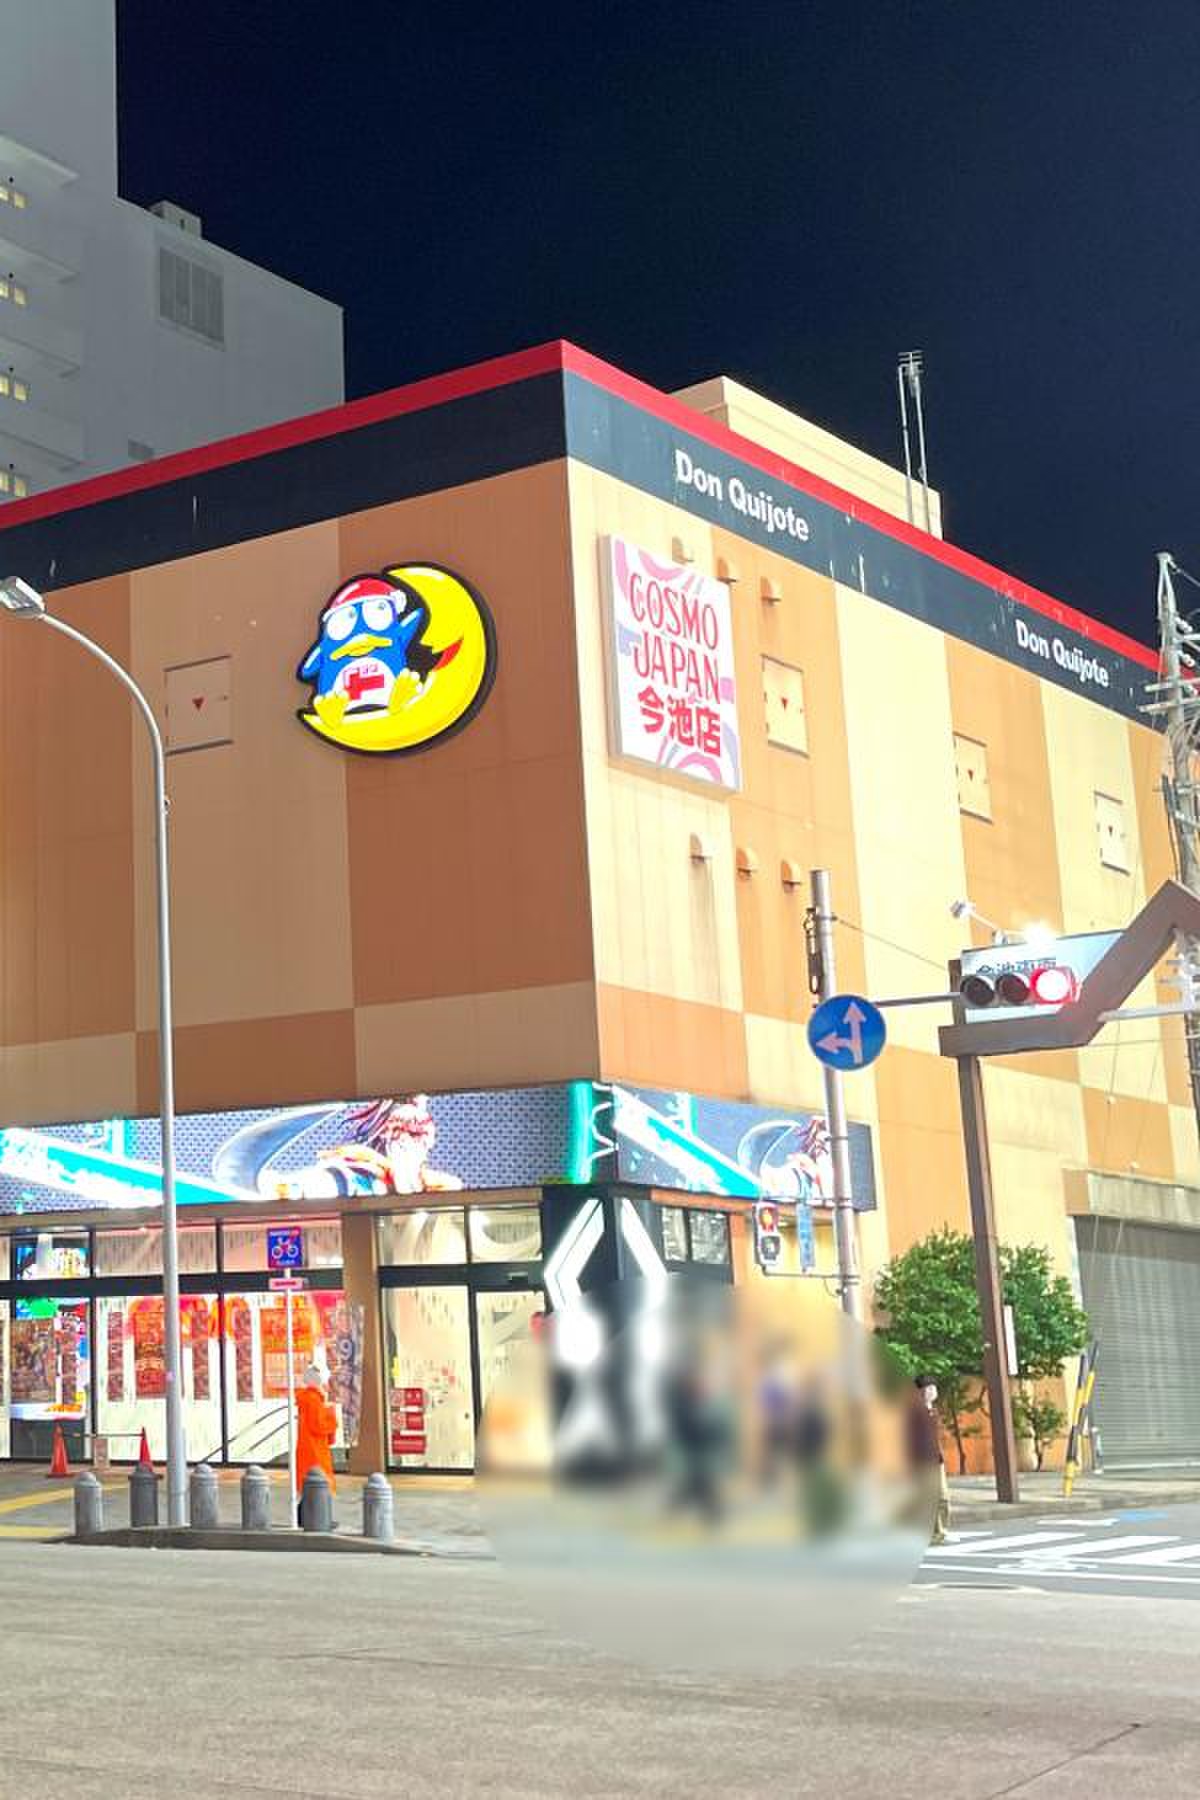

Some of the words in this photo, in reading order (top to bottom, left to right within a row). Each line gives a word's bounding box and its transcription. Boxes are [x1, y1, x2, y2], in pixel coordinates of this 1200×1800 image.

[675, 448, 723, 501] Don
[728, 479, 809, 542] Quijote
[628, 571, 719, 651] COSMO
[632, 630, 720, 704] JAPAN
[1015, 617, 1051, 661] Don
[1052, 637, 1109, 689] Quijote
[635, 685, 722, 757] 今池店
